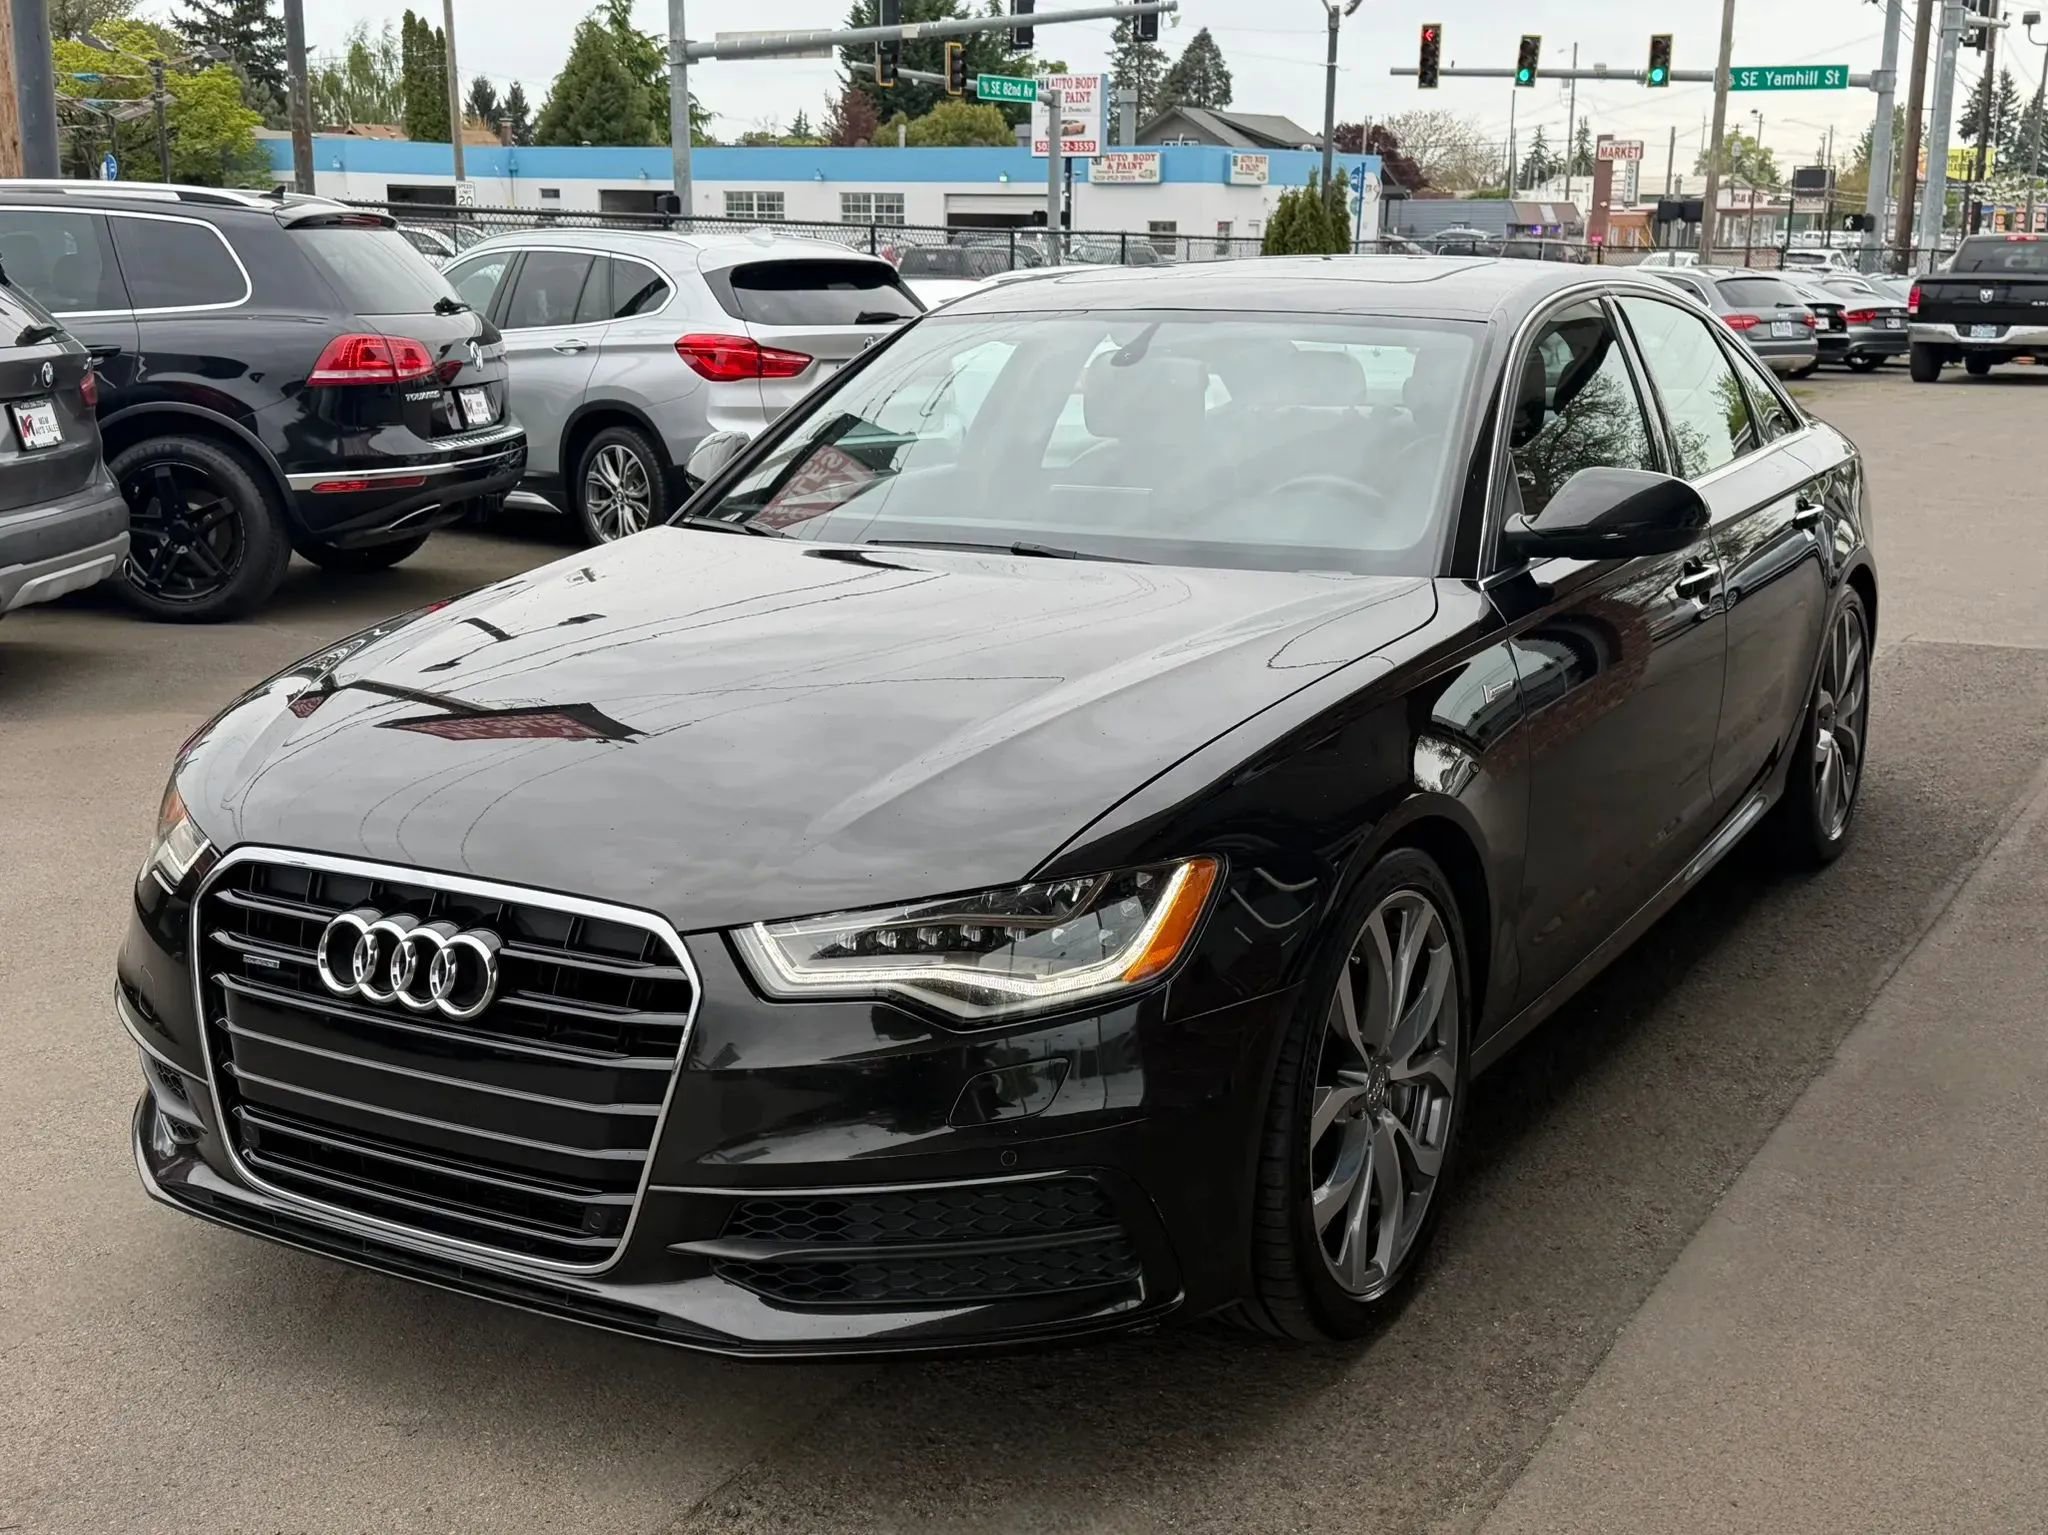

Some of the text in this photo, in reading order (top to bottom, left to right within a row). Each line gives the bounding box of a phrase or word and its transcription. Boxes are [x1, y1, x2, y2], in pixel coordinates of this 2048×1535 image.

[1051, 77, 1074, 89] AUTO
[1075, 77, 1099, 89] BODY
[1740, 69, 1840, 86] SE Yamhill St
[991, 81, 1001, 95] SE
[1002, 82, 1021, 97] 82nd
[1023, 83, 1033, 97] Av
[1065, 92, 1091, 103] PAINT
[1104, 153, 1128, 161] AUTO
[1133, 153, 1157, 161] BODY
[1600, 147, 1640, 159] MARKET
[1116, 162, 1144, 170] PAINT
[459, 195, 473, 207] 20
